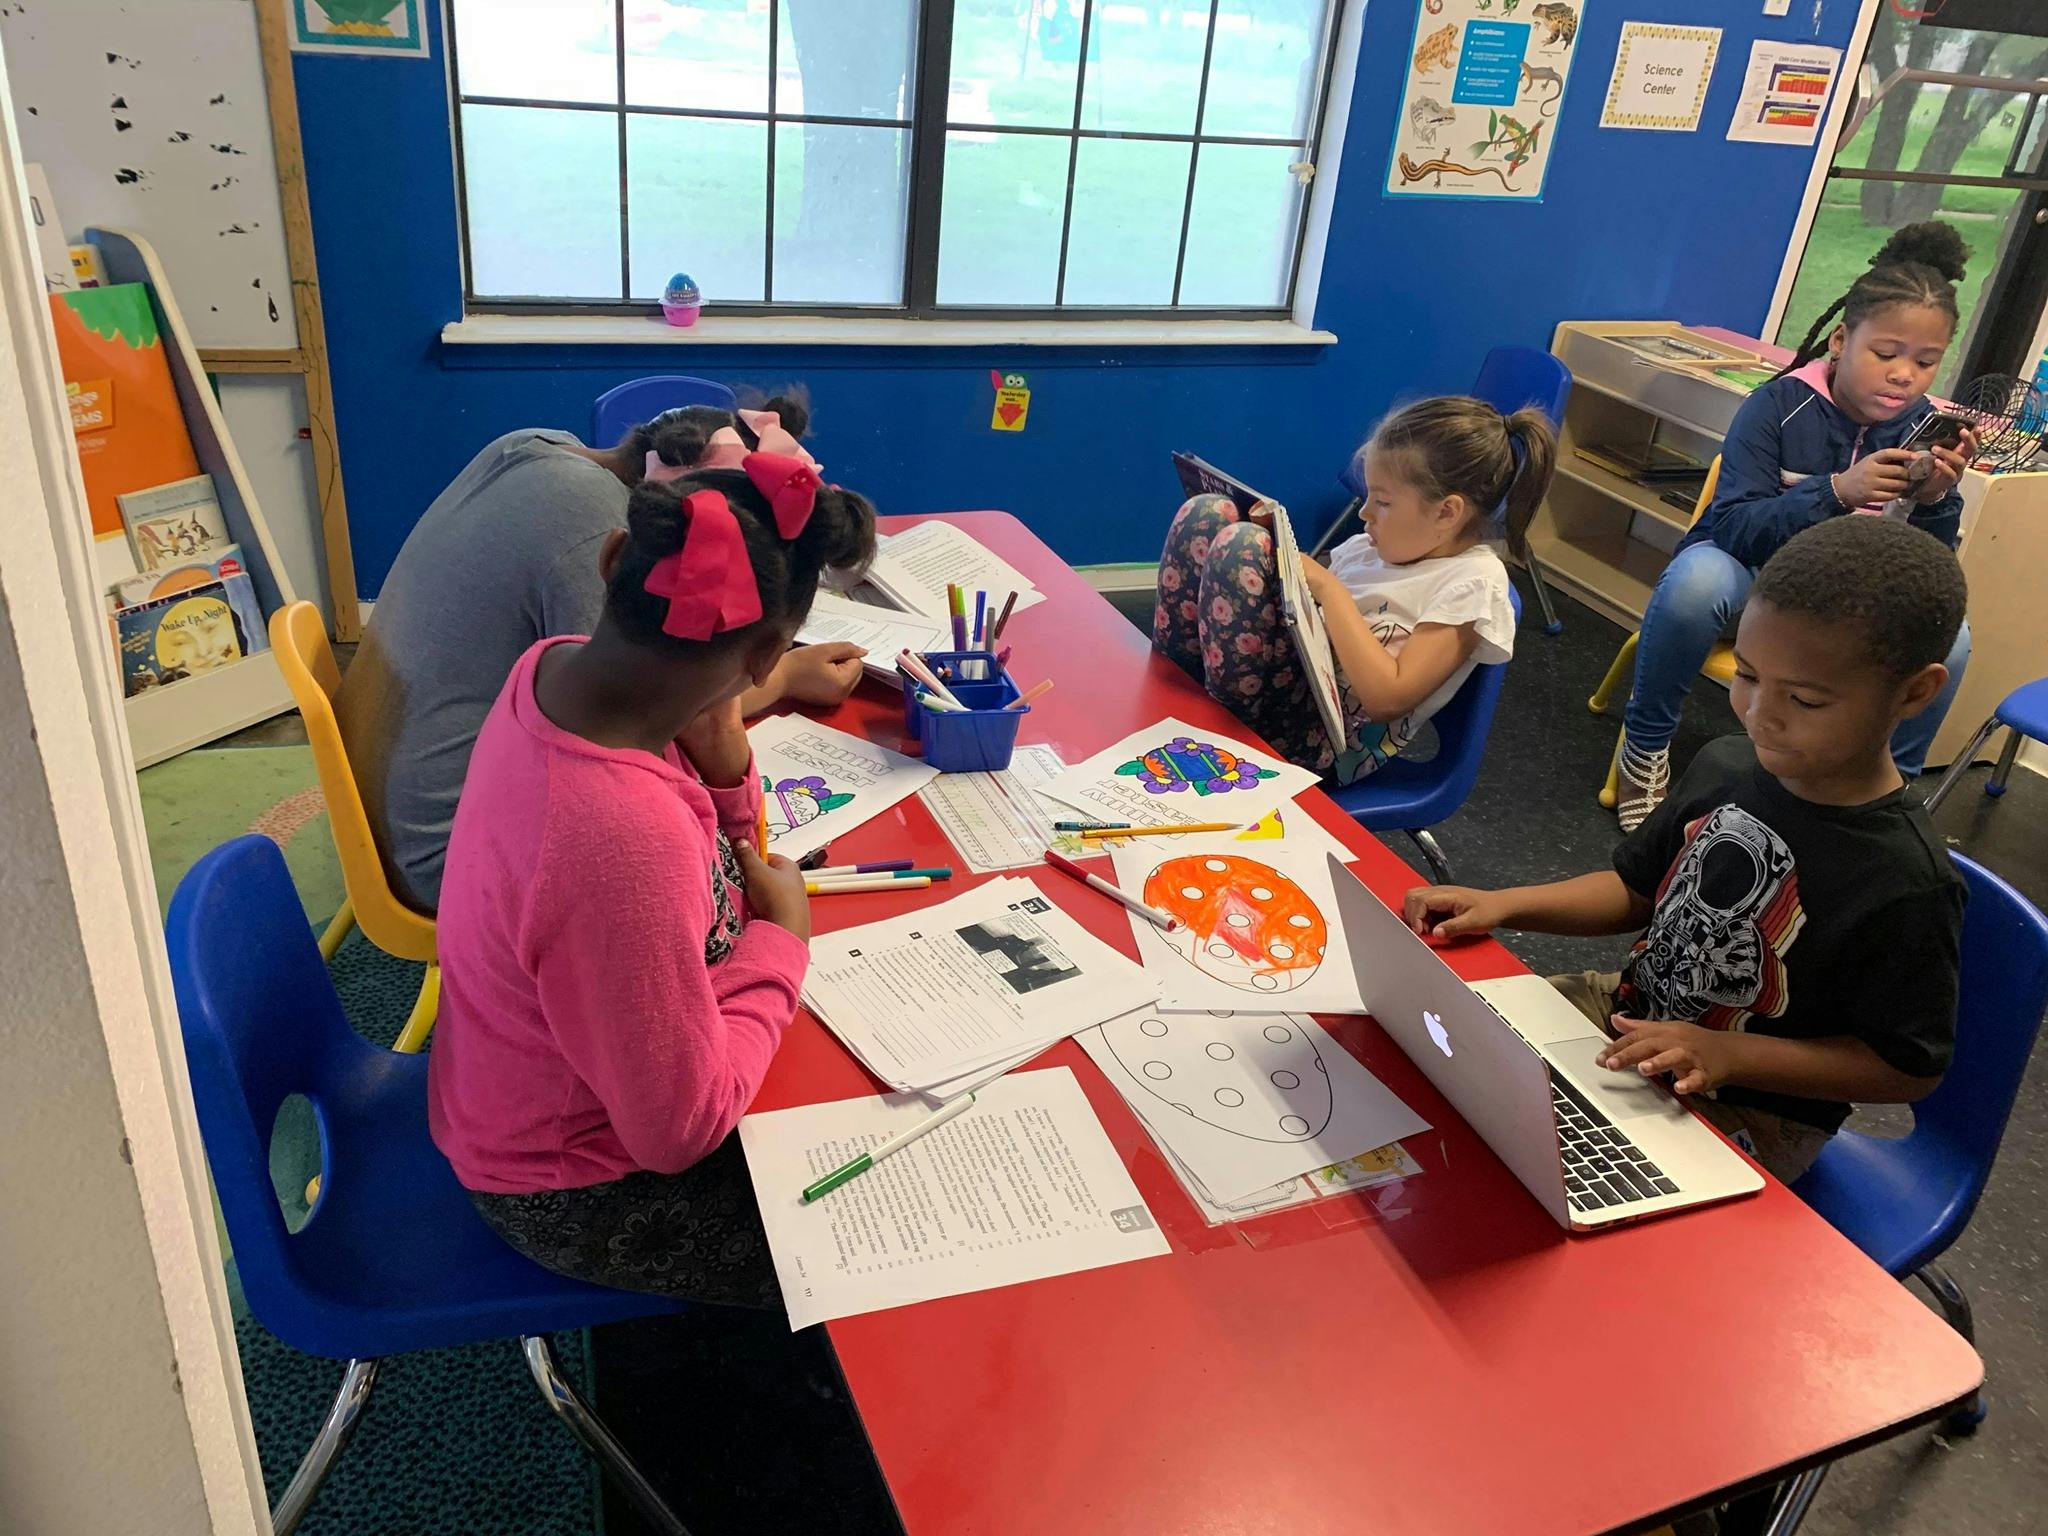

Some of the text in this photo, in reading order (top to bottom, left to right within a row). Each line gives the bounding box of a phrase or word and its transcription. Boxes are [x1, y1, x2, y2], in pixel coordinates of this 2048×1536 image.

[1644, 63, 1683, 76] Science
[1643, 82, 1676, 95] Center
[160, 618, 186, 633] Wake
[203, 605, 228, 620] Night
[792, 731, 895, 777] Happy
[771, 740, 877, 789] Easter
[1022, 902, 1039, 912] 34
[1112, 1213, 1132, 1229] 34
